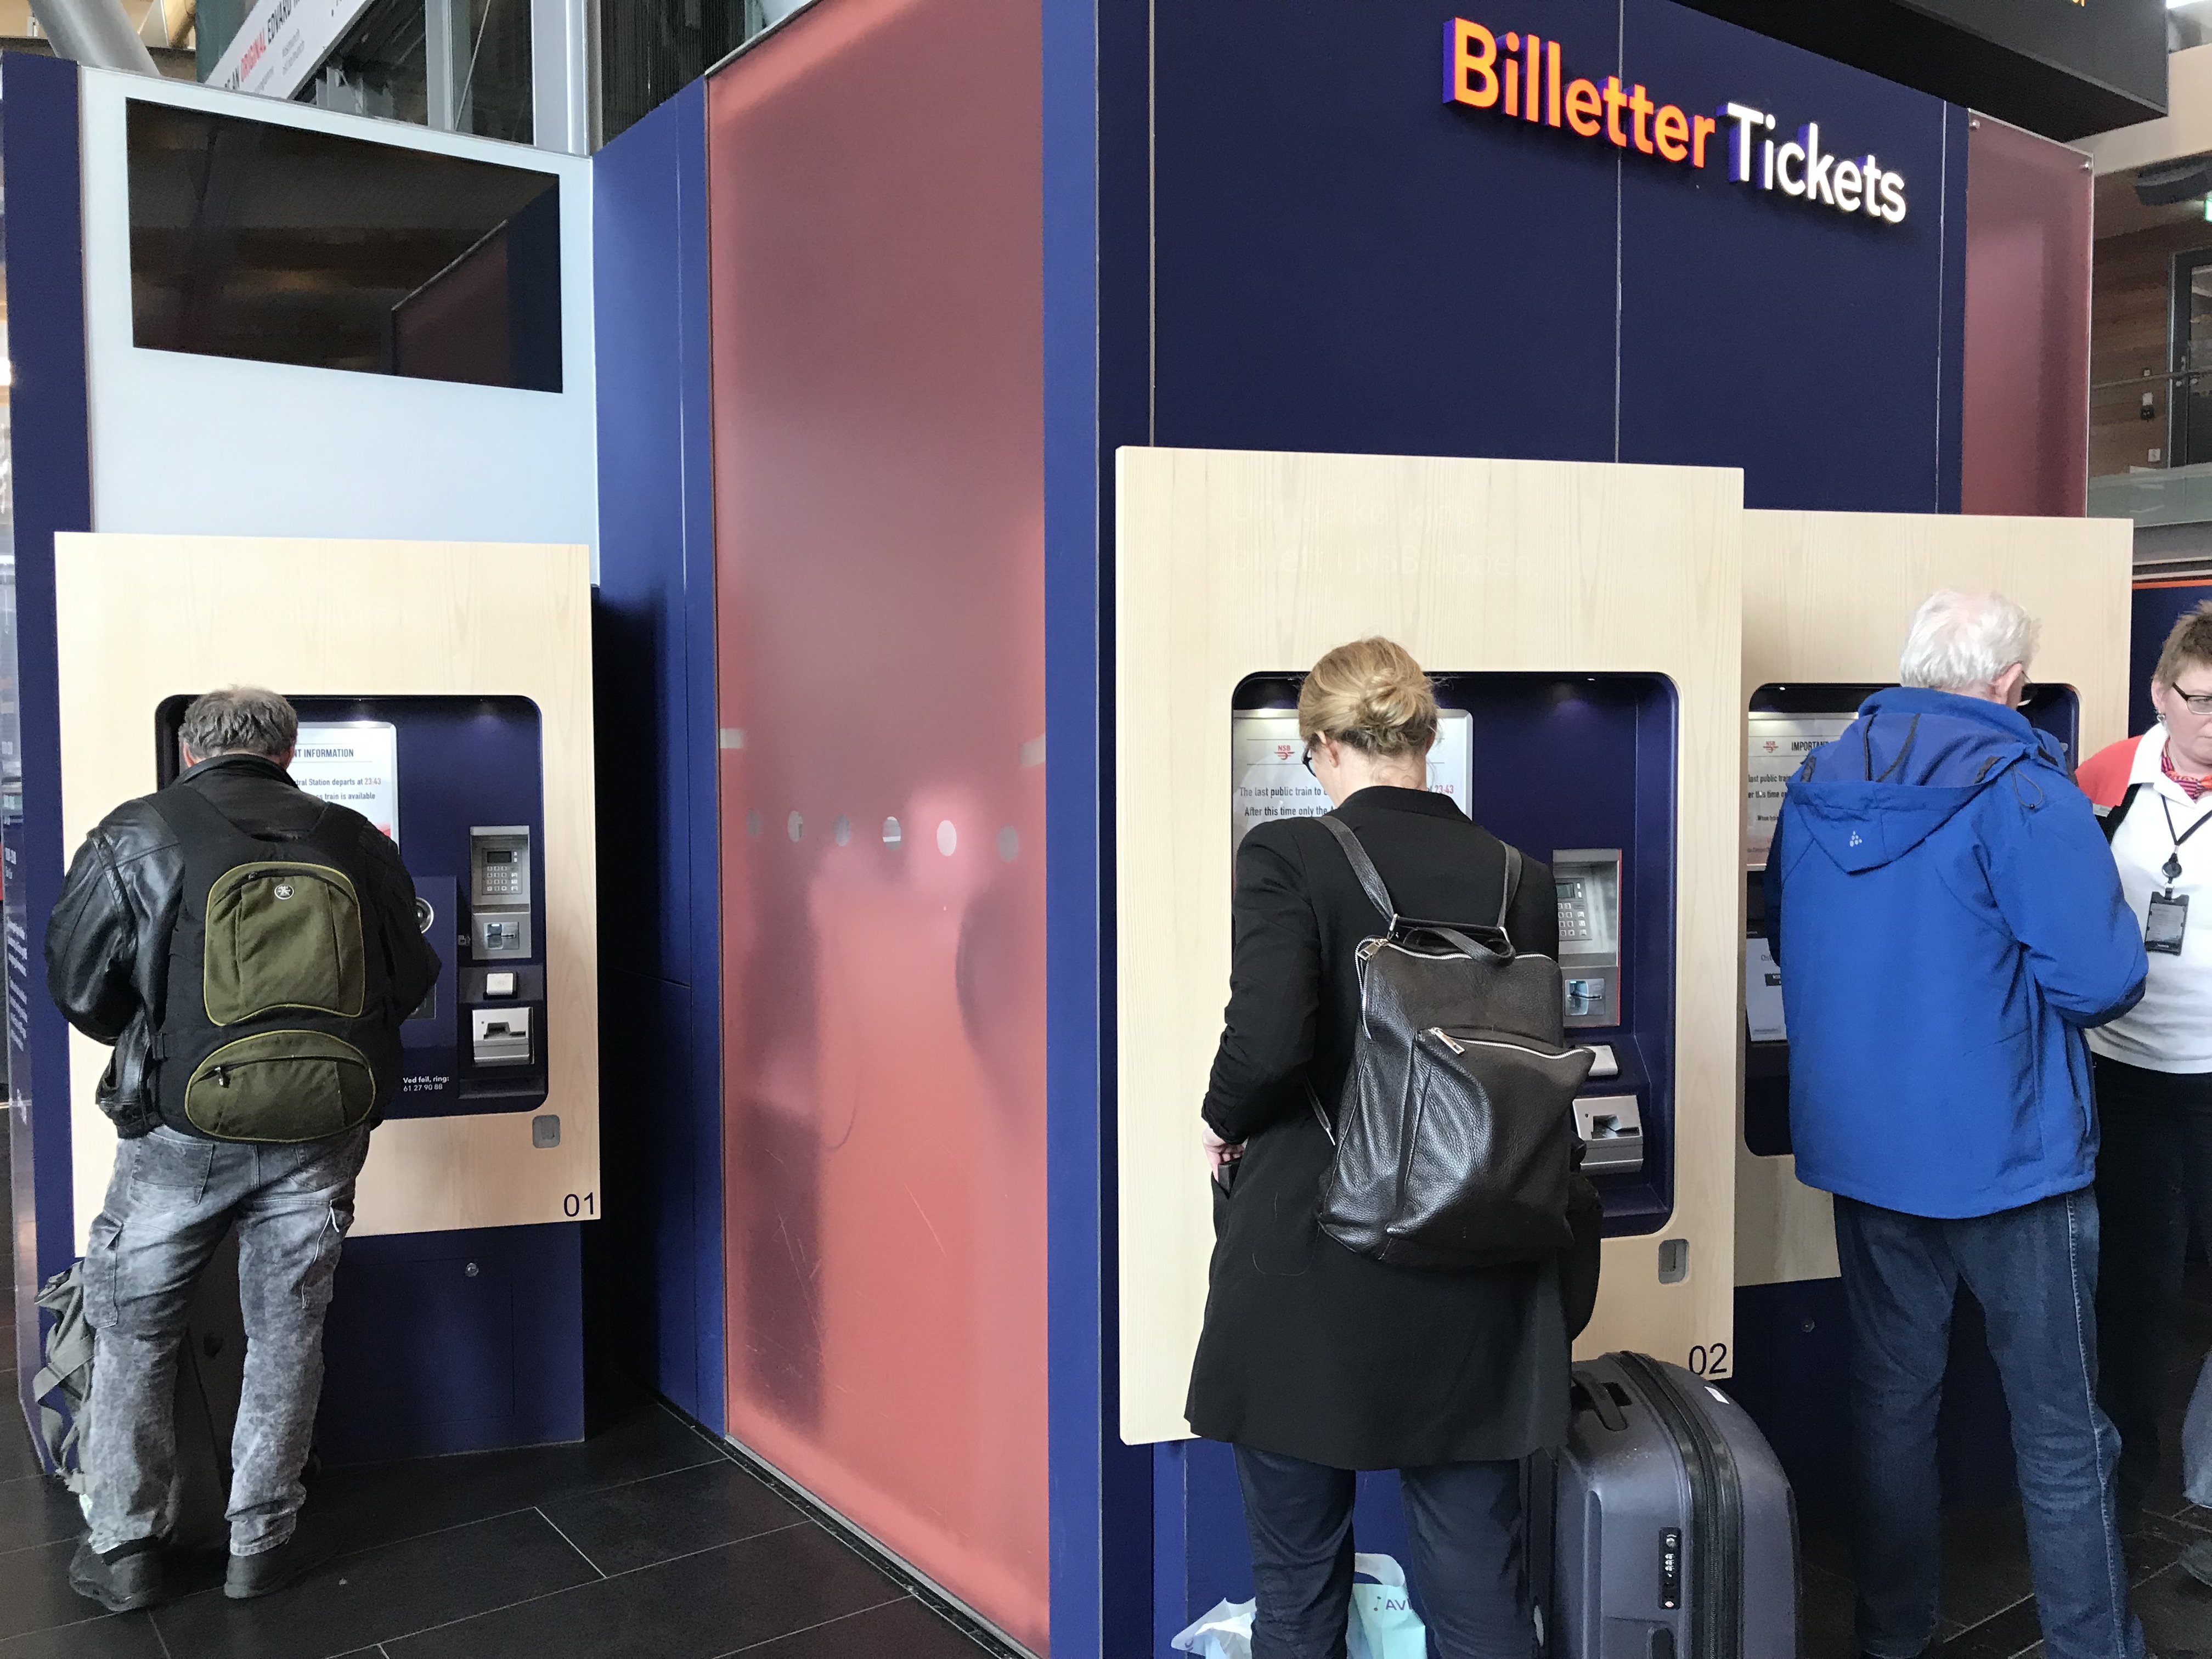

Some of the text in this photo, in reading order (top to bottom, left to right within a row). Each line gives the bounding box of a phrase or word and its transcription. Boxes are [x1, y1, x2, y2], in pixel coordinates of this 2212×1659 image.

[1444, 16, 1907, 223] Billetter Tickets
[303, 749, 354, 758] INFORMATION
[332, 778, 355, 787] departs
[1760, 774, 1778, 784] public
[348, 792, 376, 800] available
[1239, 787, 1252, 796] The
[1255, 787, 1268, 796] last
[1271, 786, 1293, 799] public
[1295, 786, 1312, 796] train
[1314, 787, 1321, 795] to
[1244, 806, 1262, 816] After
[1265, 806, 1278, 816] this
[1280, 806, 1296, 816] time
[1299, 805, 1313, 817] only
[1316, 805, 1328, 815] the
[564, 1192, 594, 1217] 01
[1689, 1342, 1727, 1375] 02
